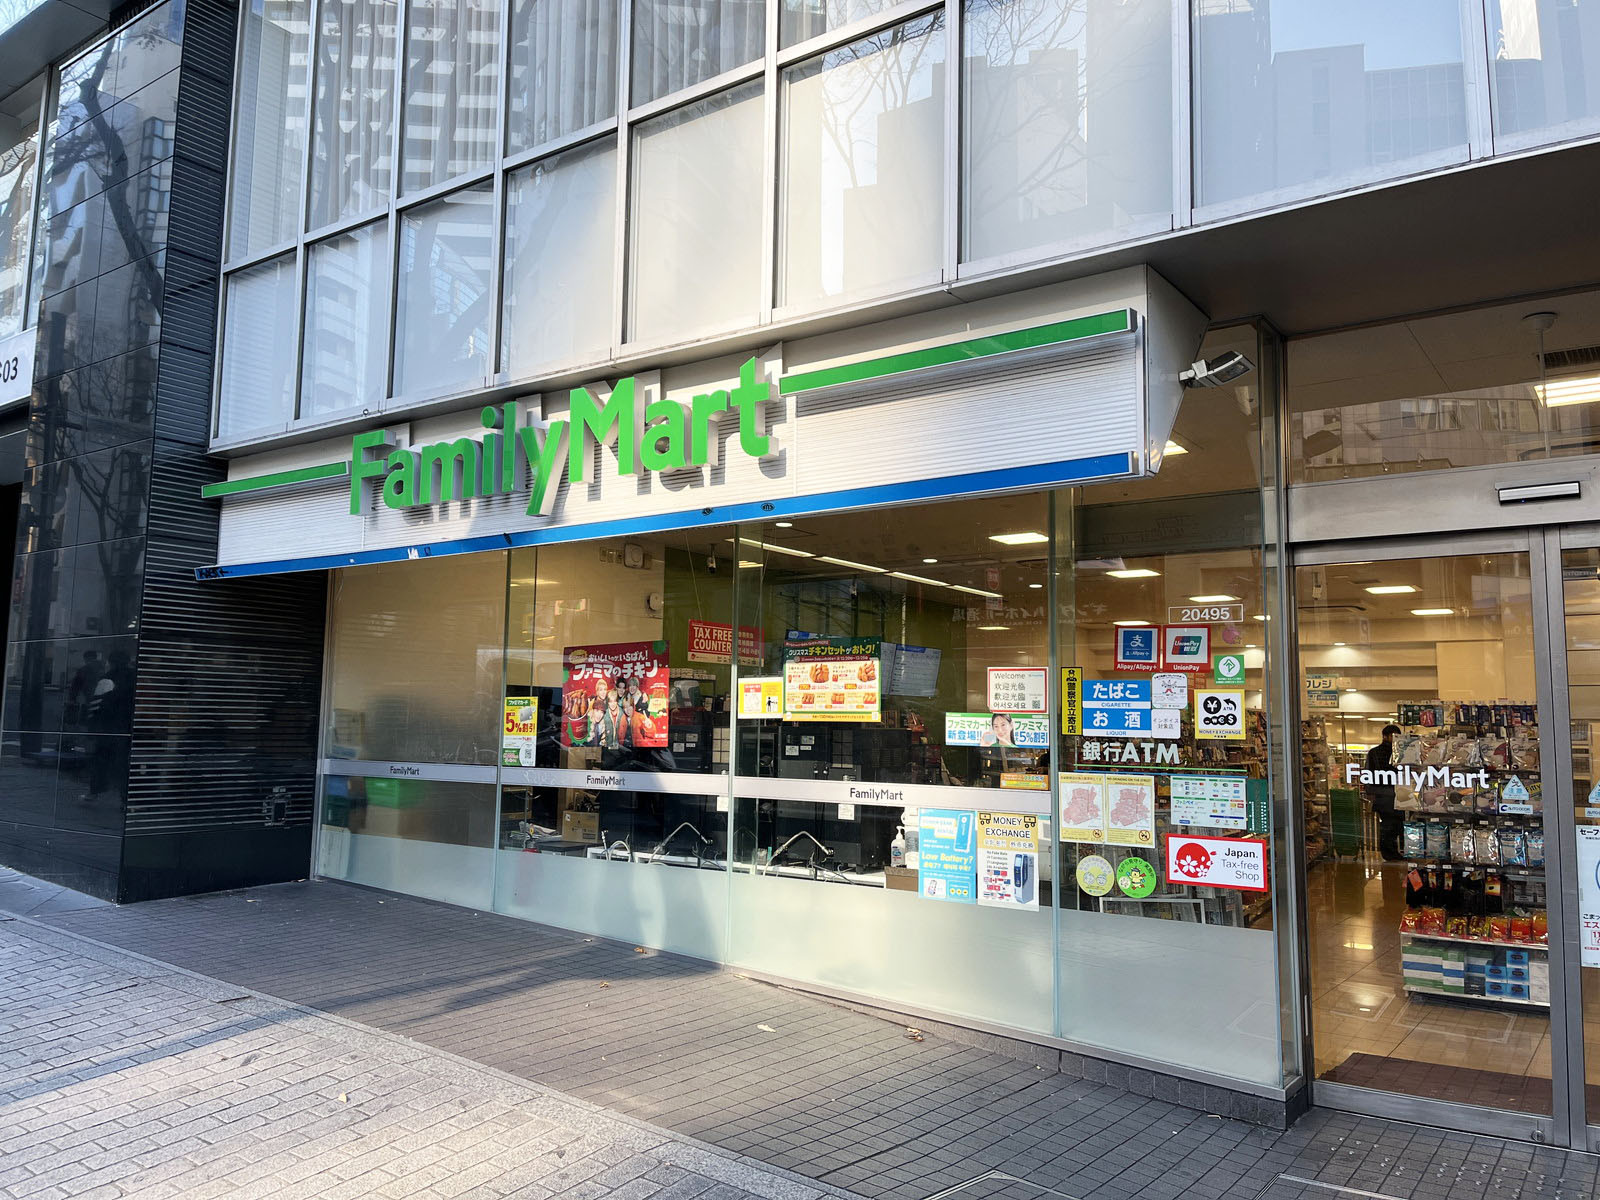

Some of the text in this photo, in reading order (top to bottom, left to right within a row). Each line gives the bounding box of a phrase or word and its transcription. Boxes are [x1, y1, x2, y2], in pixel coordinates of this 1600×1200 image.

[350, 356, 775, 517] FamilyMart
[1181, 607, 1230, 621] 20495
[693, 627, 711, 639] TAX
[712, 629, 732, 642] FREE
[693, 639, 732, 653] COUNTER
[1174, 640, 1200, 649] UnionPay
[573, 659, 658, 680] ファミマのチキン
[994, 672, 1026, 680] Welcome
[1093, 682, 1140, 699] たばこ
[1067, 682, 1076, 734] 警察官立寄店
[947, 719, 991, 730] ファミマカード
[1014, 721, 1048, 731] ファミマで
[947, 730, 982, 741] 新登場!!
[1082, 741, 1181, 765] 銀行ATM
[389, 766, 420, 776] FamilyMart
[1346, 763, 1490, 791] FamilyMart
[586, 775, 625, 787] FamilyMart
[849, 787, 904, 801] FamilyMart
[993, 816, 1023, 826] MONEY
[985, 827, 1031, 839] EXCHANGE
[1225, 847, 1259, 859] Japan.
[1221, 859, 1259, 871] Tax-free
[1235, 870, 1260, 883] Shop
